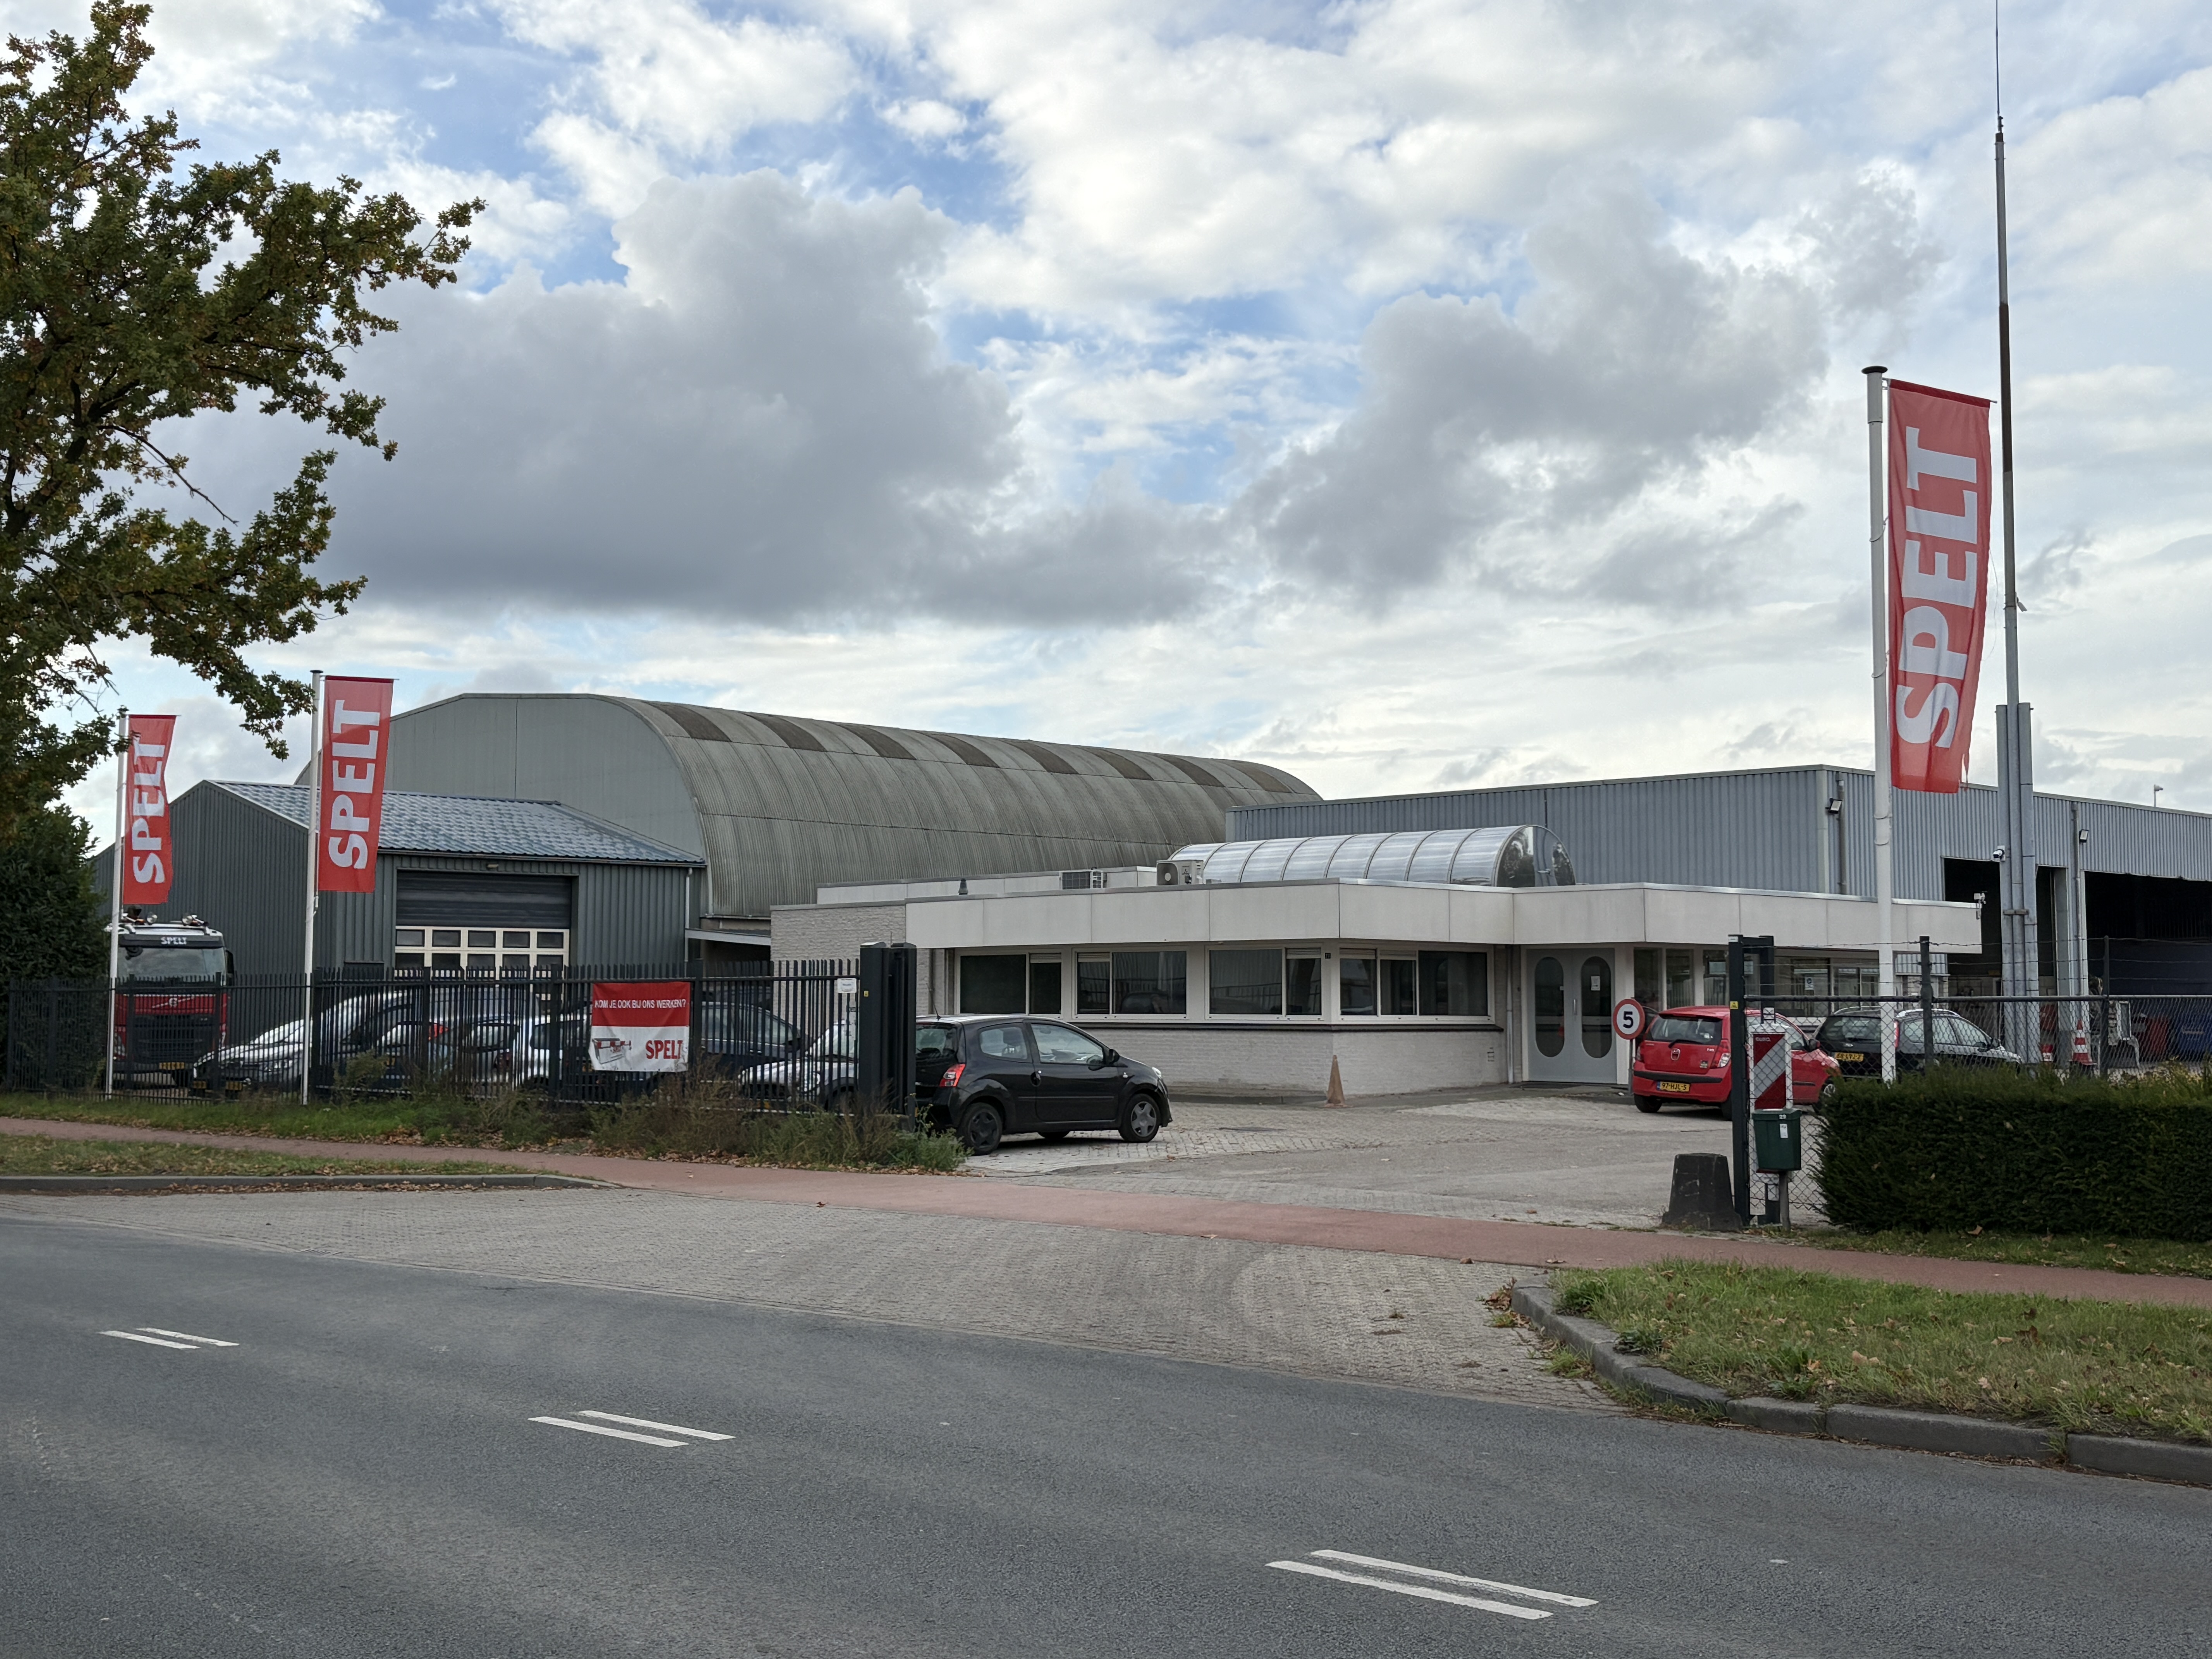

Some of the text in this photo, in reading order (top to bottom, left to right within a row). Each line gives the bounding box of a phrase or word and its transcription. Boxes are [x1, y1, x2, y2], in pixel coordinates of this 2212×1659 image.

[1896, 426, 1977, 748] SPELT
[328, 699, 380, 869] SPELT
[132, 737, 165, 884] SPELT
[161, 936, 187, 945] SPELT
[595, 999, 686, 1008] KOM JE OOK BIJ ONS WERKEN?
[1623, 1011, 1633, 1029] 5
[646, 1040, 683, 1059] SPELT
